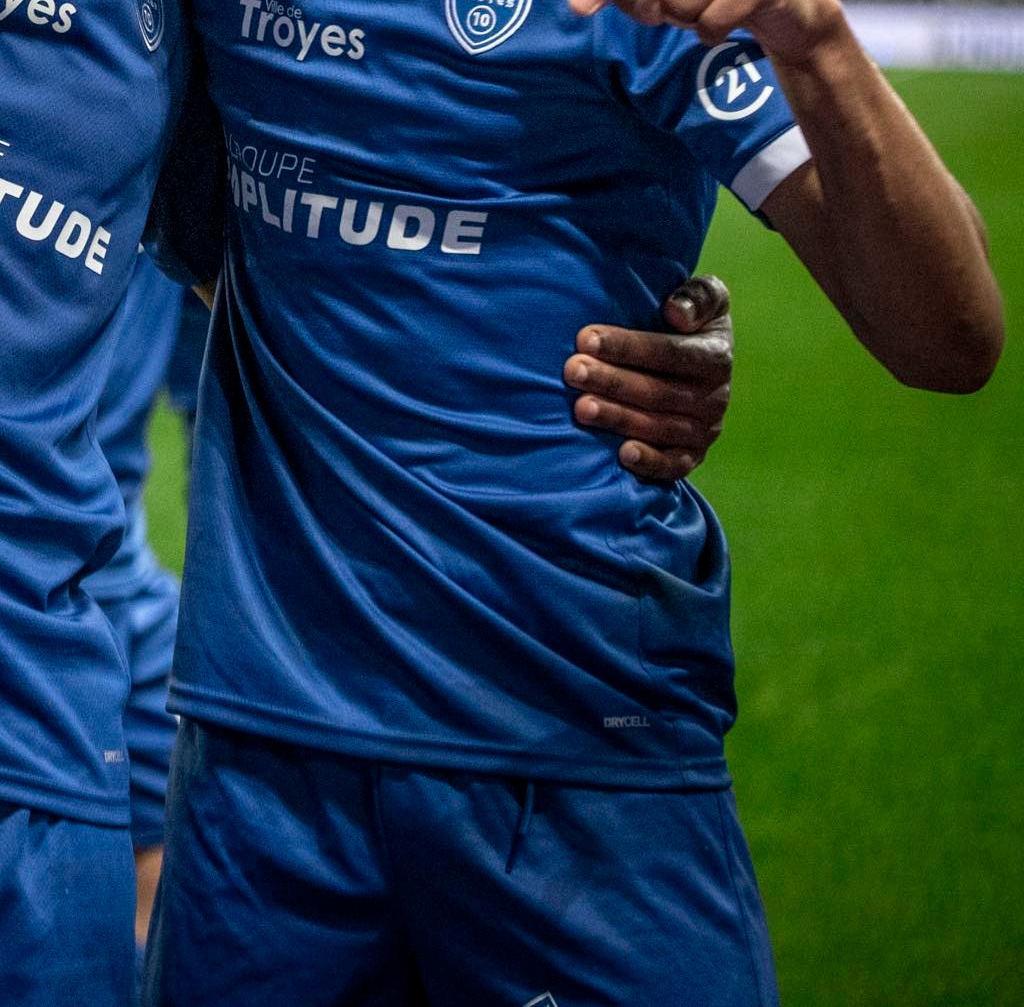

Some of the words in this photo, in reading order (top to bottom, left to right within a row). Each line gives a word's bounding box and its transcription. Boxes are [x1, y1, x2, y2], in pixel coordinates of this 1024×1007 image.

[286, 5, 303, 19] de
[472, 11, 492, 28] 10
[714, 51, 763, 105] 21
[604, 716, 650, 728] DRYCELL
